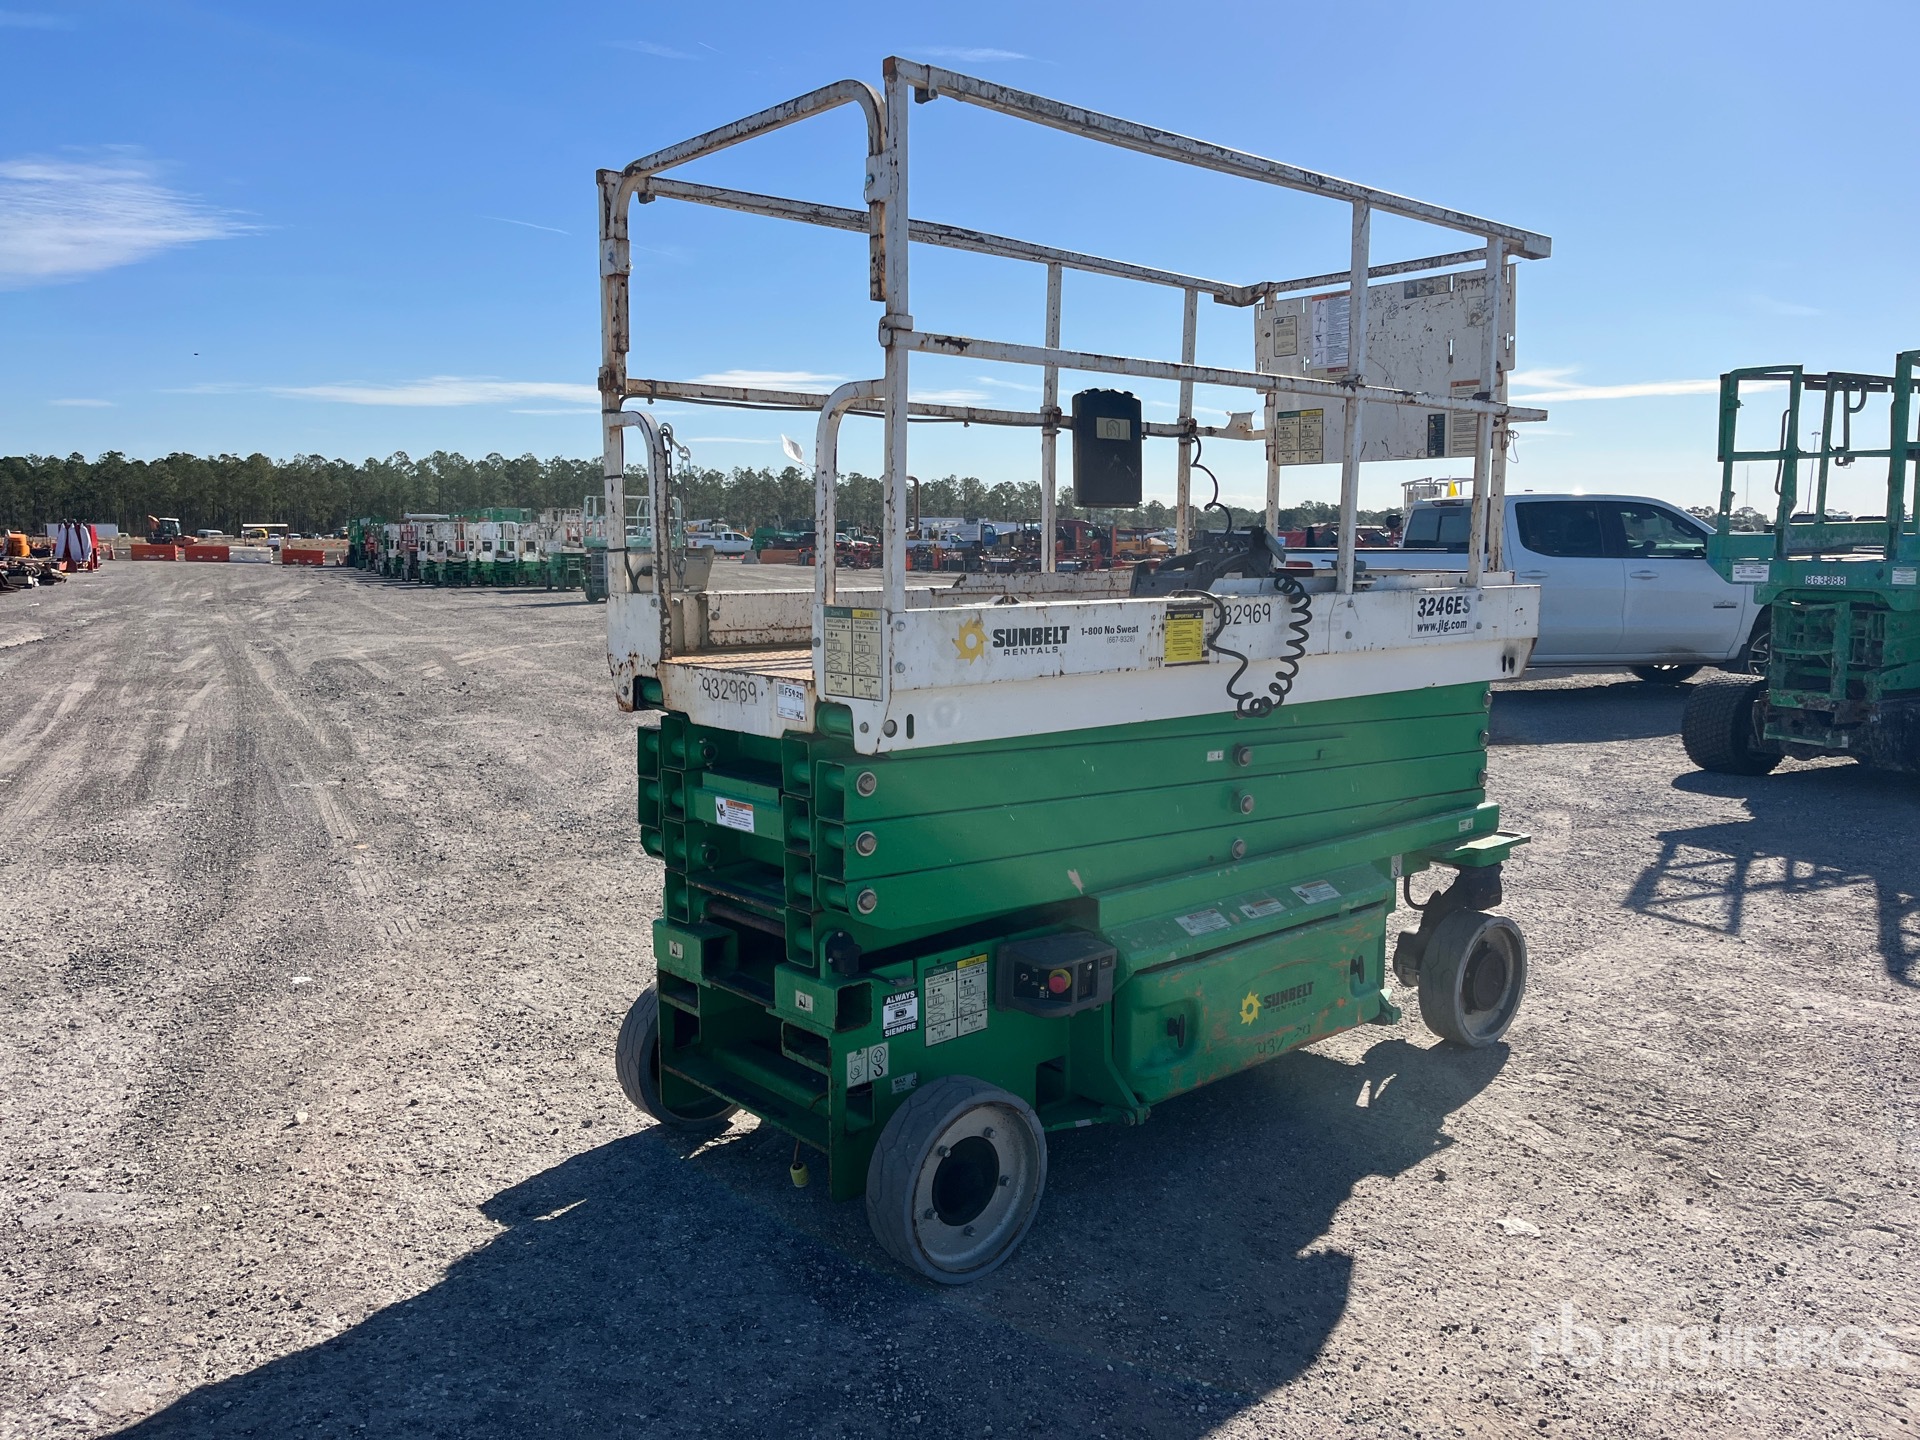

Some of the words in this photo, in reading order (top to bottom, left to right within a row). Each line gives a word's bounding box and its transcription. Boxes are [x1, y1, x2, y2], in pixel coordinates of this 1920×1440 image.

[1417, 595, 1472, 618] 3246ES
[1080, 626, 1103, 636] 1-800
[1104, 625, 1115, 634] No
[1116, 624, 1139, 634] Sweat
[1417, 619, 1468, 633] www.jlg.com
[992, 625, 1071, 649] SUNBELT
[1106, 634, 1136, 644] (667-9328)
[1003, 646, 1059, 657] RENTALS
[702, 677, 757, 704] 932969
[886, 990, 916, 1005] ALWAYS
[1263, 981, 1314, 1010] SUNBELT
[884, 1022, 917, 1038] SIEMPRE
